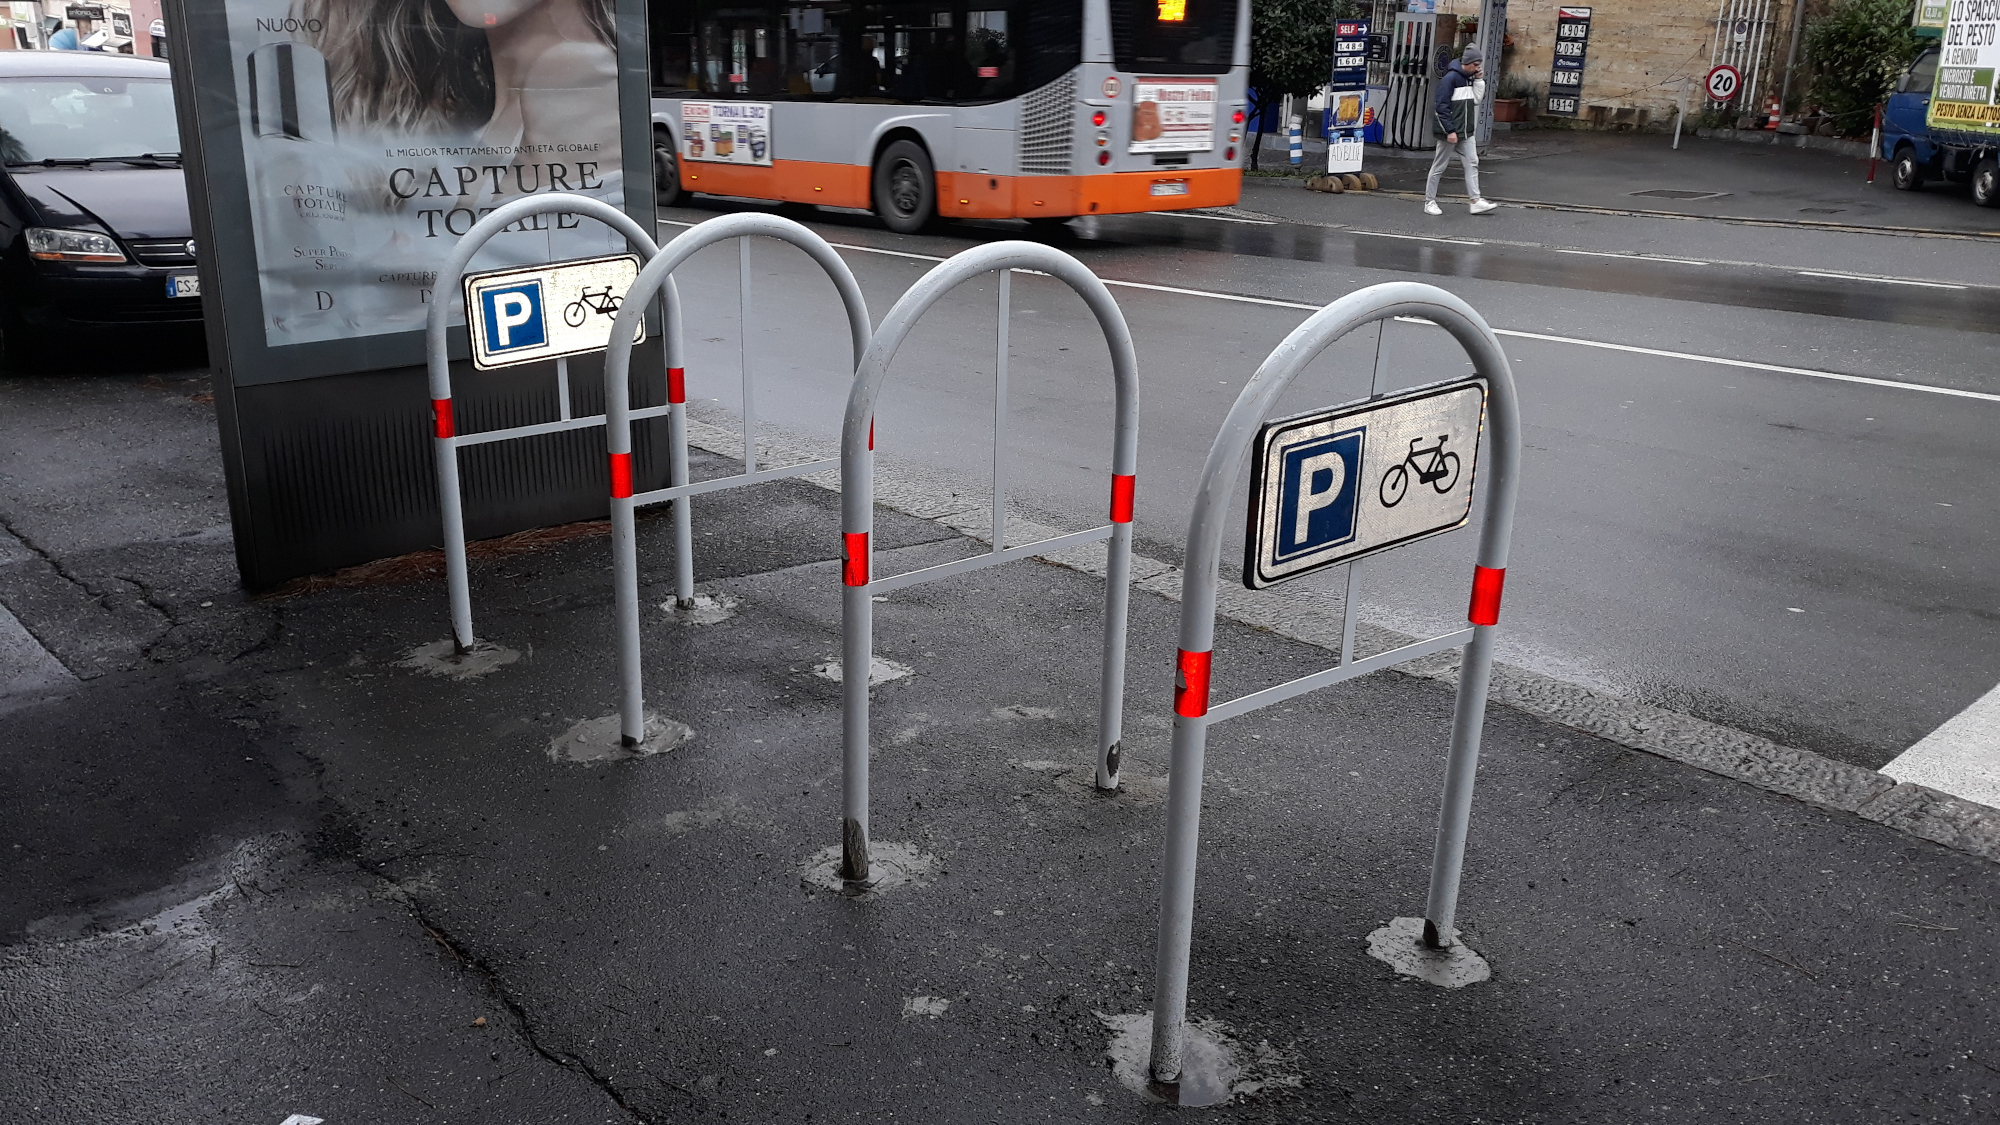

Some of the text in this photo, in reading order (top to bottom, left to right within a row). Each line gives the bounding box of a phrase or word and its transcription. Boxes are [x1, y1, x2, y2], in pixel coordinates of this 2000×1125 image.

[1951, 0, 1964, 21] LO
[256, 18, 322, 32] NUOVO
[1340, 25, 1355, 34] SELF
[1561, 25, 1584, 36] 1.904
[1947, 24, 1996, 46] DEL PESTO
[1557, 42, 1580, 54] 2.034
[1944, 48, 1979, 65] A GENOVA
[1555, 72, 1578, 83] 1.784
[1712, 73, 1733, 92] 20
[1941, 69, 1976, 84] INGROSSO E
[1939, 85, 1987, 100] VENDITA DIRETTA
[1935, 103, 1955, 118] PESTO
[1955, 104, 1976, 119] SENZA
[385, 149, 394, 157] IL
[397, 147, 438, 157] MIGLIOR
[439, 146, 512, 156] TRATTAMENTO
[513, 142, 554, 154] ANTI-ETÀ
[389, 161, 604, 199] CAPTURE
[284, 184, 347, 203] CAPTURE
[293, 197, 346, 214] TOTALE
[378, 271, 438, 283] CAPTURE
[493, 291, 532, 346] P
[1294, 451, 1346, 545] P
